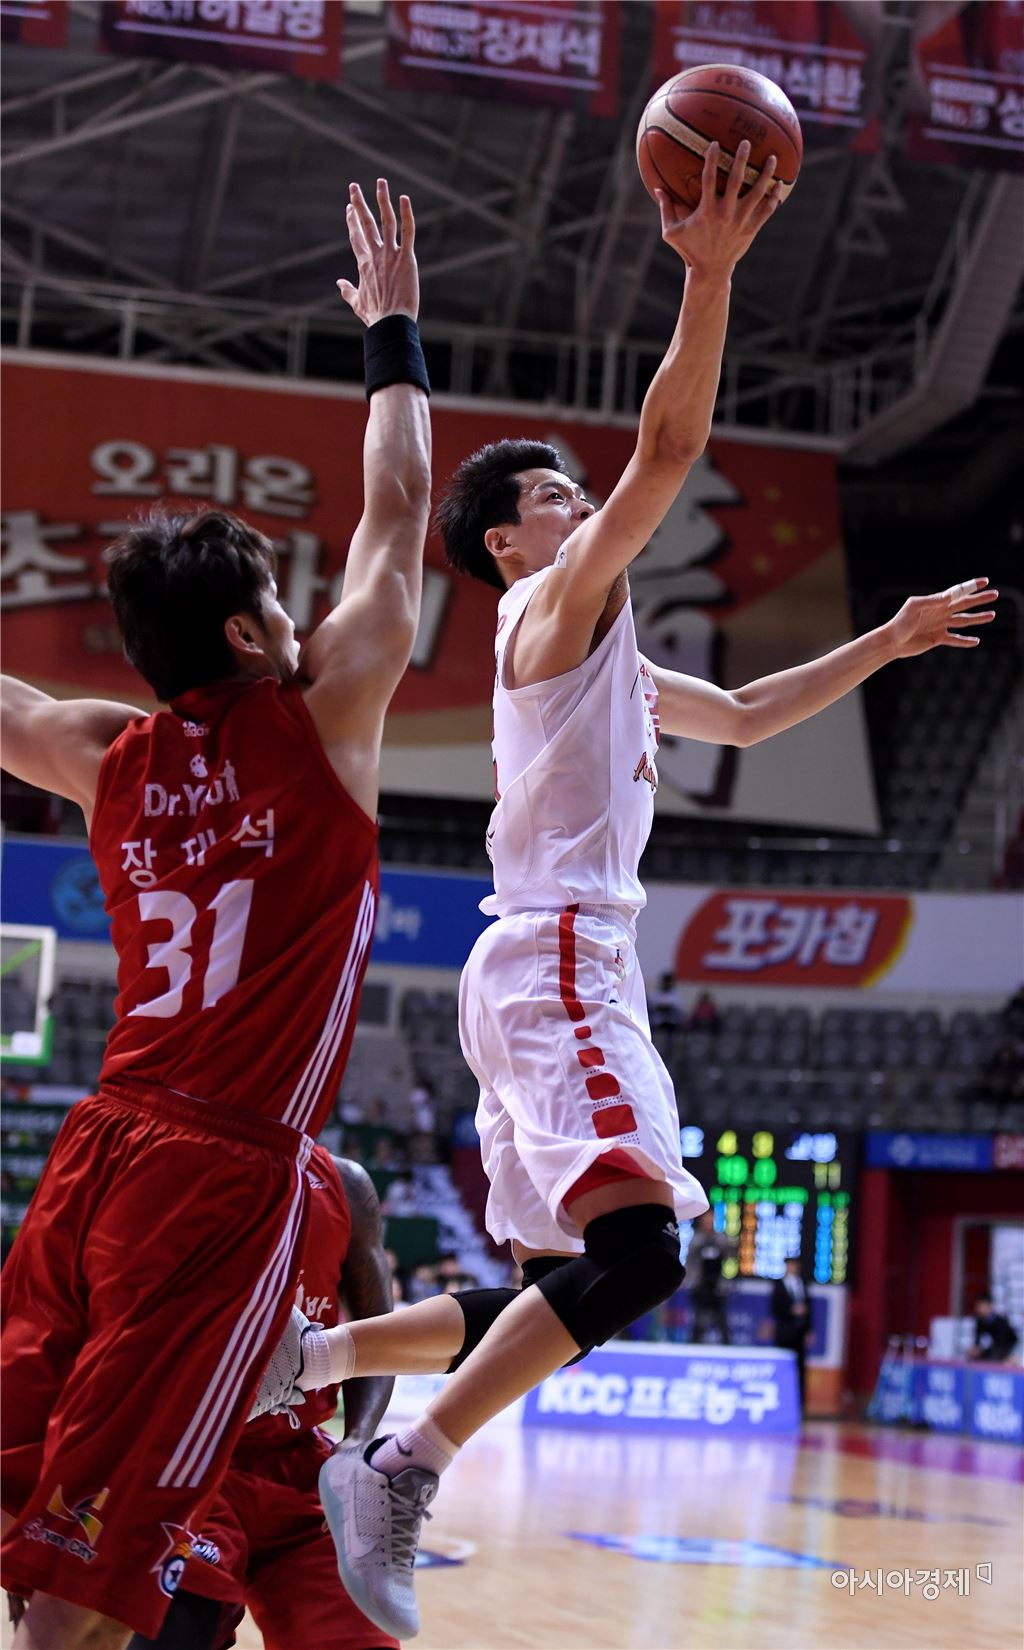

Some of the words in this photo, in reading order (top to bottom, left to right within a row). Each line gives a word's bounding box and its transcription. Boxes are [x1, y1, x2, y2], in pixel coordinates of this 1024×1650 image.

[482, 16, 600, 76] 장재석
[90, 440, 312, 517] 오리온
[127, 879, 255, 1018] 31
